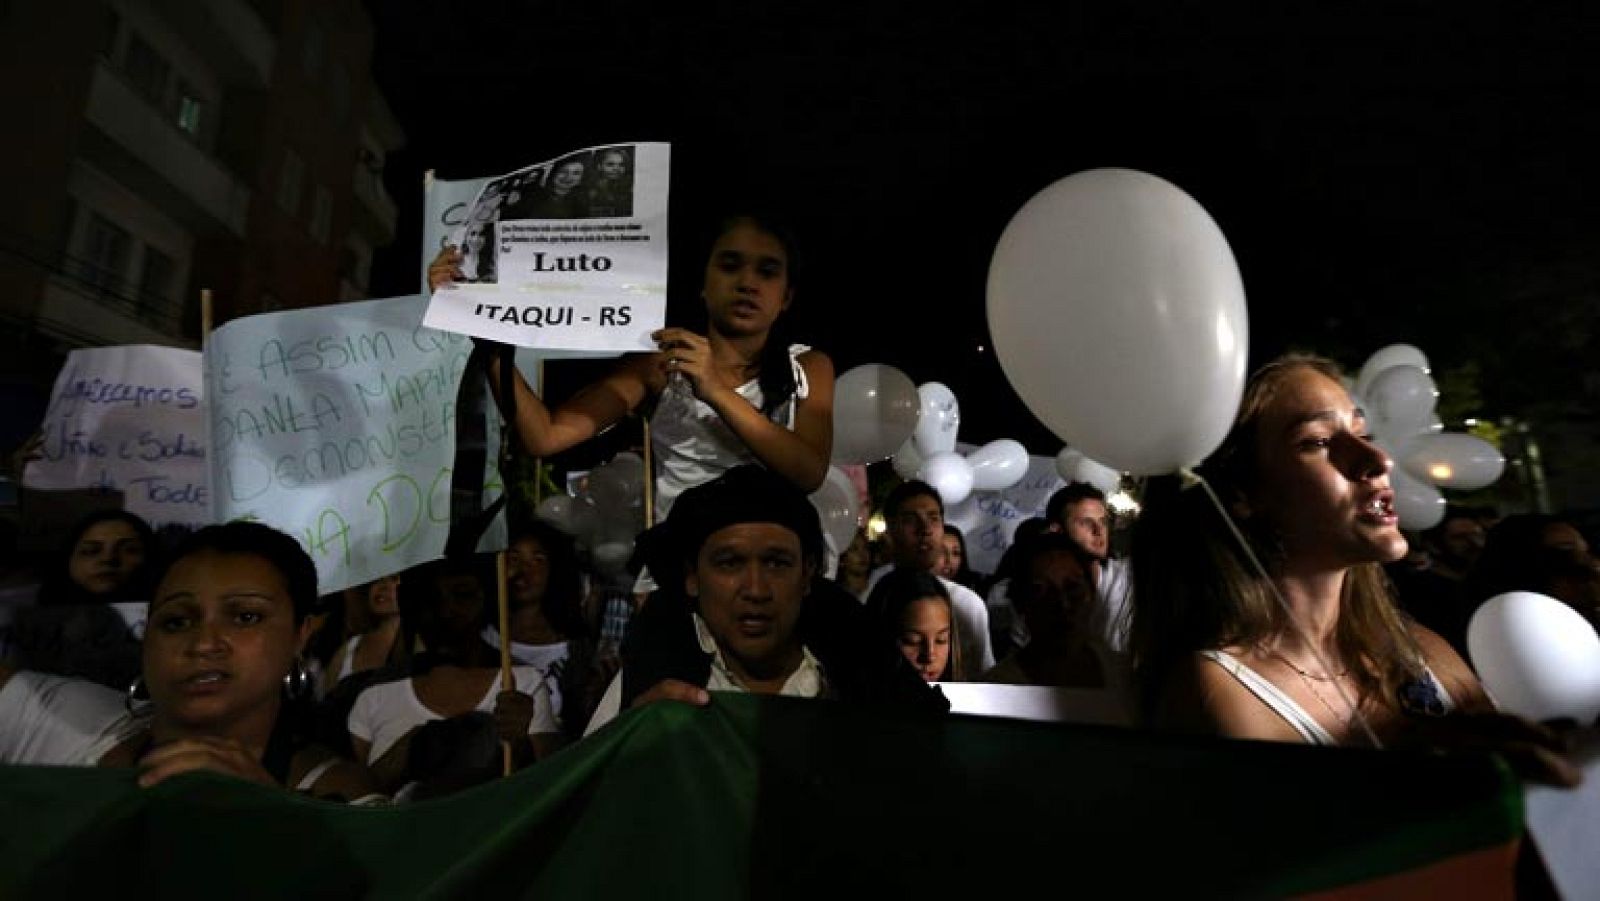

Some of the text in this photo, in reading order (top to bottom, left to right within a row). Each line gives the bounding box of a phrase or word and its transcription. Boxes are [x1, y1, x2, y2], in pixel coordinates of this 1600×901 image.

[533, 252, 612, 272] Luto
[475, 304, 574, 328] ITAQUI
[600, 306, 632, 326] RS
[258, 331, 395, 379] ASSIM
